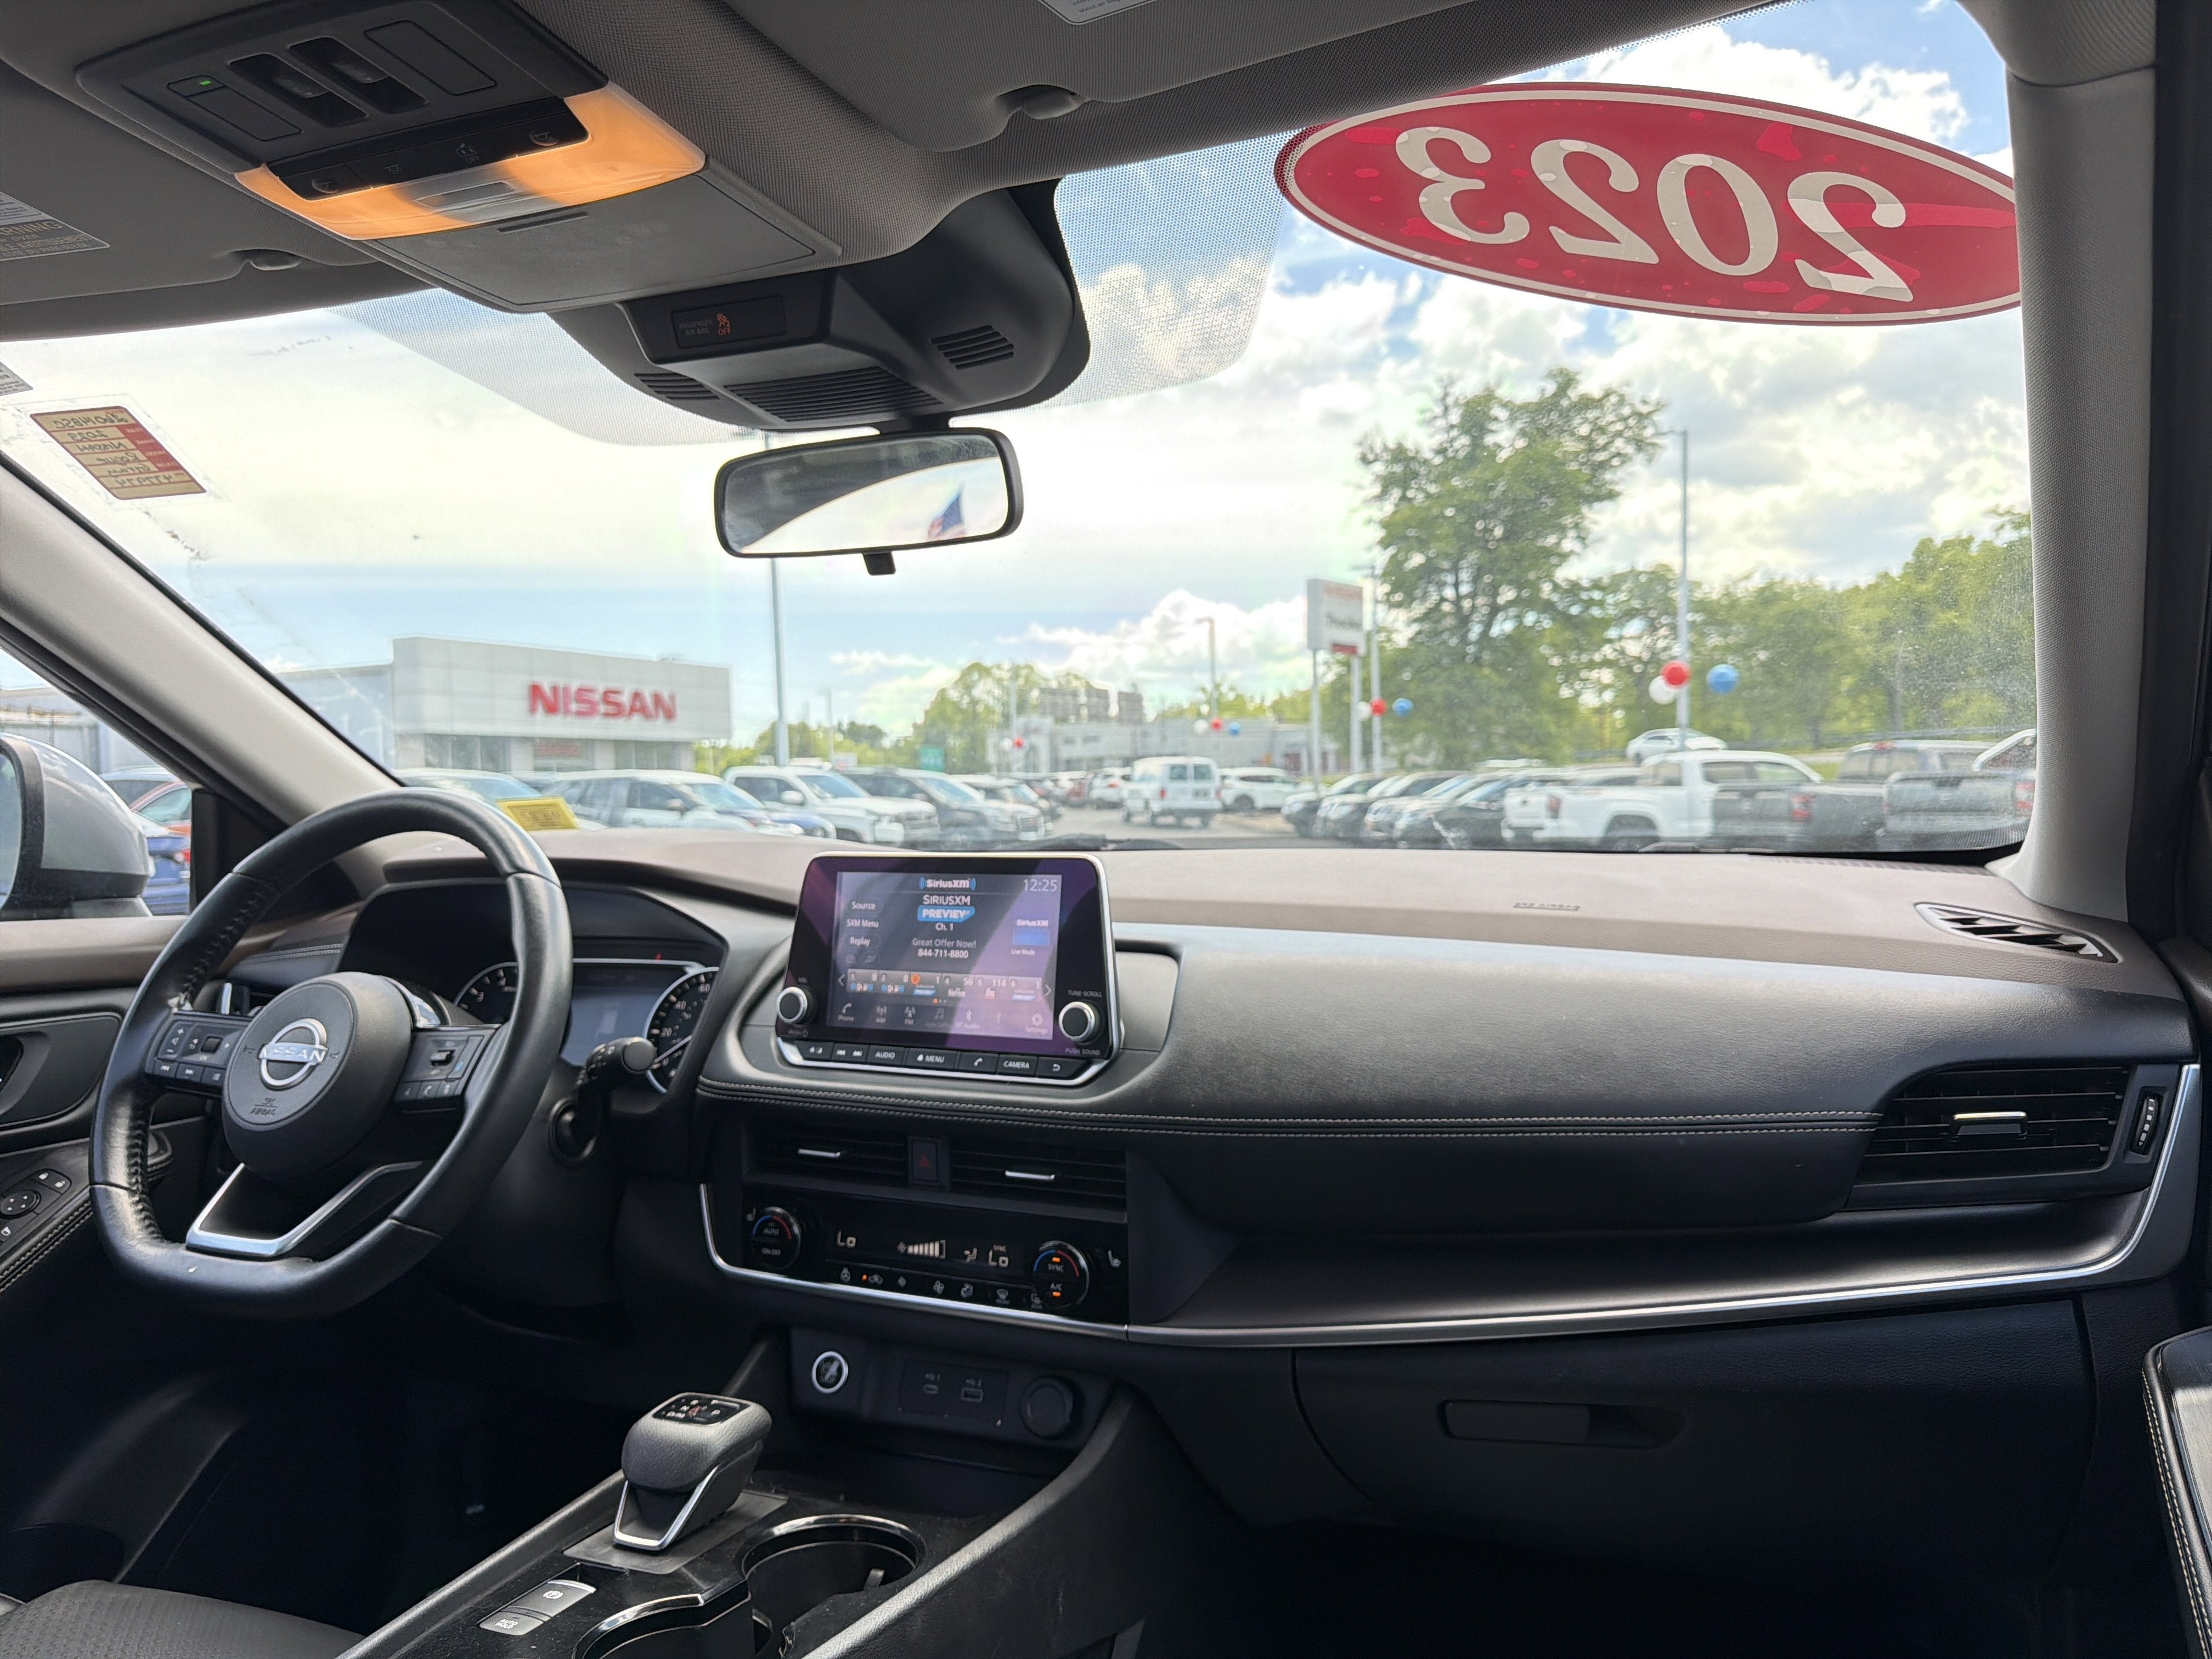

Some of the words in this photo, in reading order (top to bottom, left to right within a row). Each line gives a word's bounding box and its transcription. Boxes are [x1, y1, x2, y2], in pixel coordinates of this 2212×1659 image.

[679, 319, 713, 329] PASSENGER
[718, 328, 731, 336] OFF
[529, 682, 677, 721] NISSAN
[1023, 878, 1058, 892] 12:25
[923, 894, 970, 906] SIRIUSXM
[851, 901, 876, 910] Source
[847, 918, 861, 927] SXM
[861, 919, 879, 928] Menu
[935, 922, 948, 931] Ch.
[950, 923, 954, 931] 1
[850, 936, 871, 947] Replay
[911, 938, 933, 947] Great
[934, 938, 955, 947] Offer
[956, 939, 977, 948] Now!
[917, 948, 969, 959] 844-711-8800
[992, 978, 1007, 987] 114
[674, 1000, 687, 1010] 40
[659, 1026, 672, 1037] 20
[1025, 1026, 1048, 1036] Settings
[874, 1051, 895, 1059] AUDIO
[925, 1054, 945, 1063] MENU
[1003, 1059, 1030, 1069] CAMERA
[763, 1227, 779, 1235] AUTO
[837, 1231, 856, 1249] Lo
[988, 1249, 1009, 1268] Lo
[1047, 1263, 1064, 1272] SYNC
